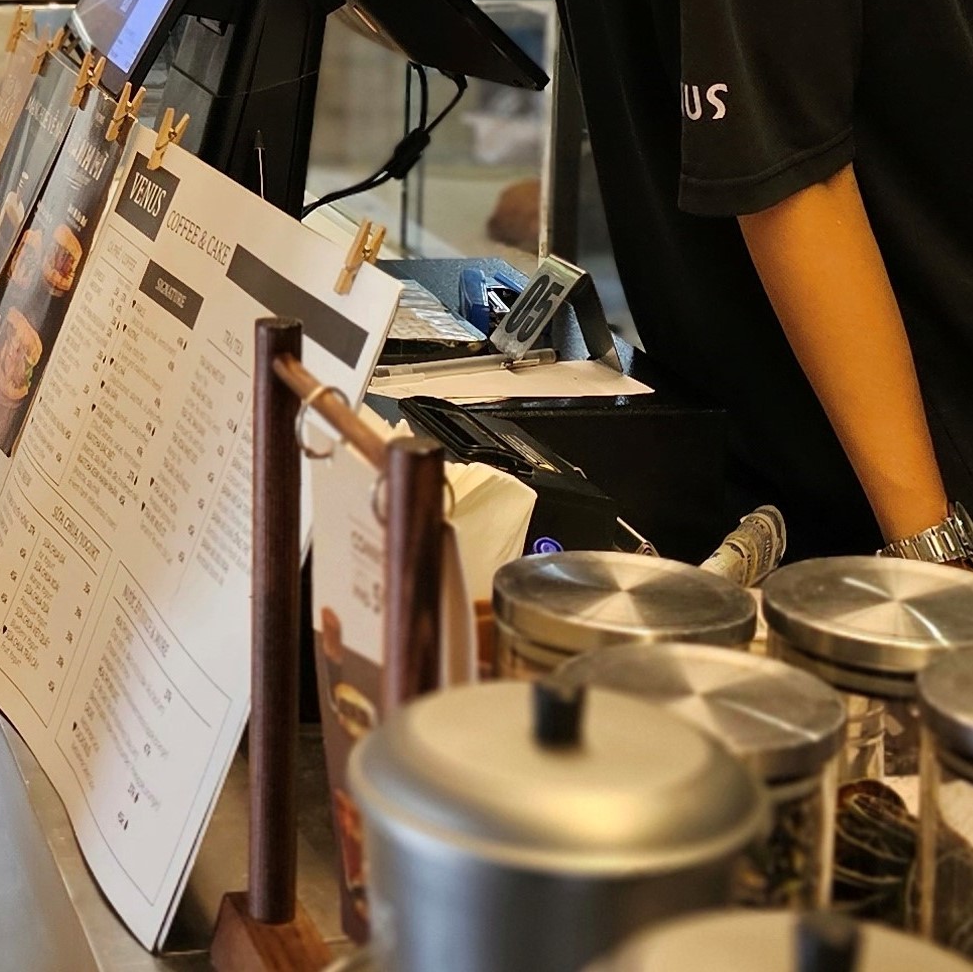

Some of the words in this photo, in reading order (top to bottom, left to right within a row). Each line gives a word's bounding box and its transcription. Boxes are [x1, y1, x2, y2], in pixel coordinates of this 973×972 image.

[129, 172, 167, 217] VENUS
[166, 210, 200, 244] COFFEE
[198, 231, 209, 249] &
[206, 236, 231, 266] CAKE
[504, 275, 566, 344] 05
